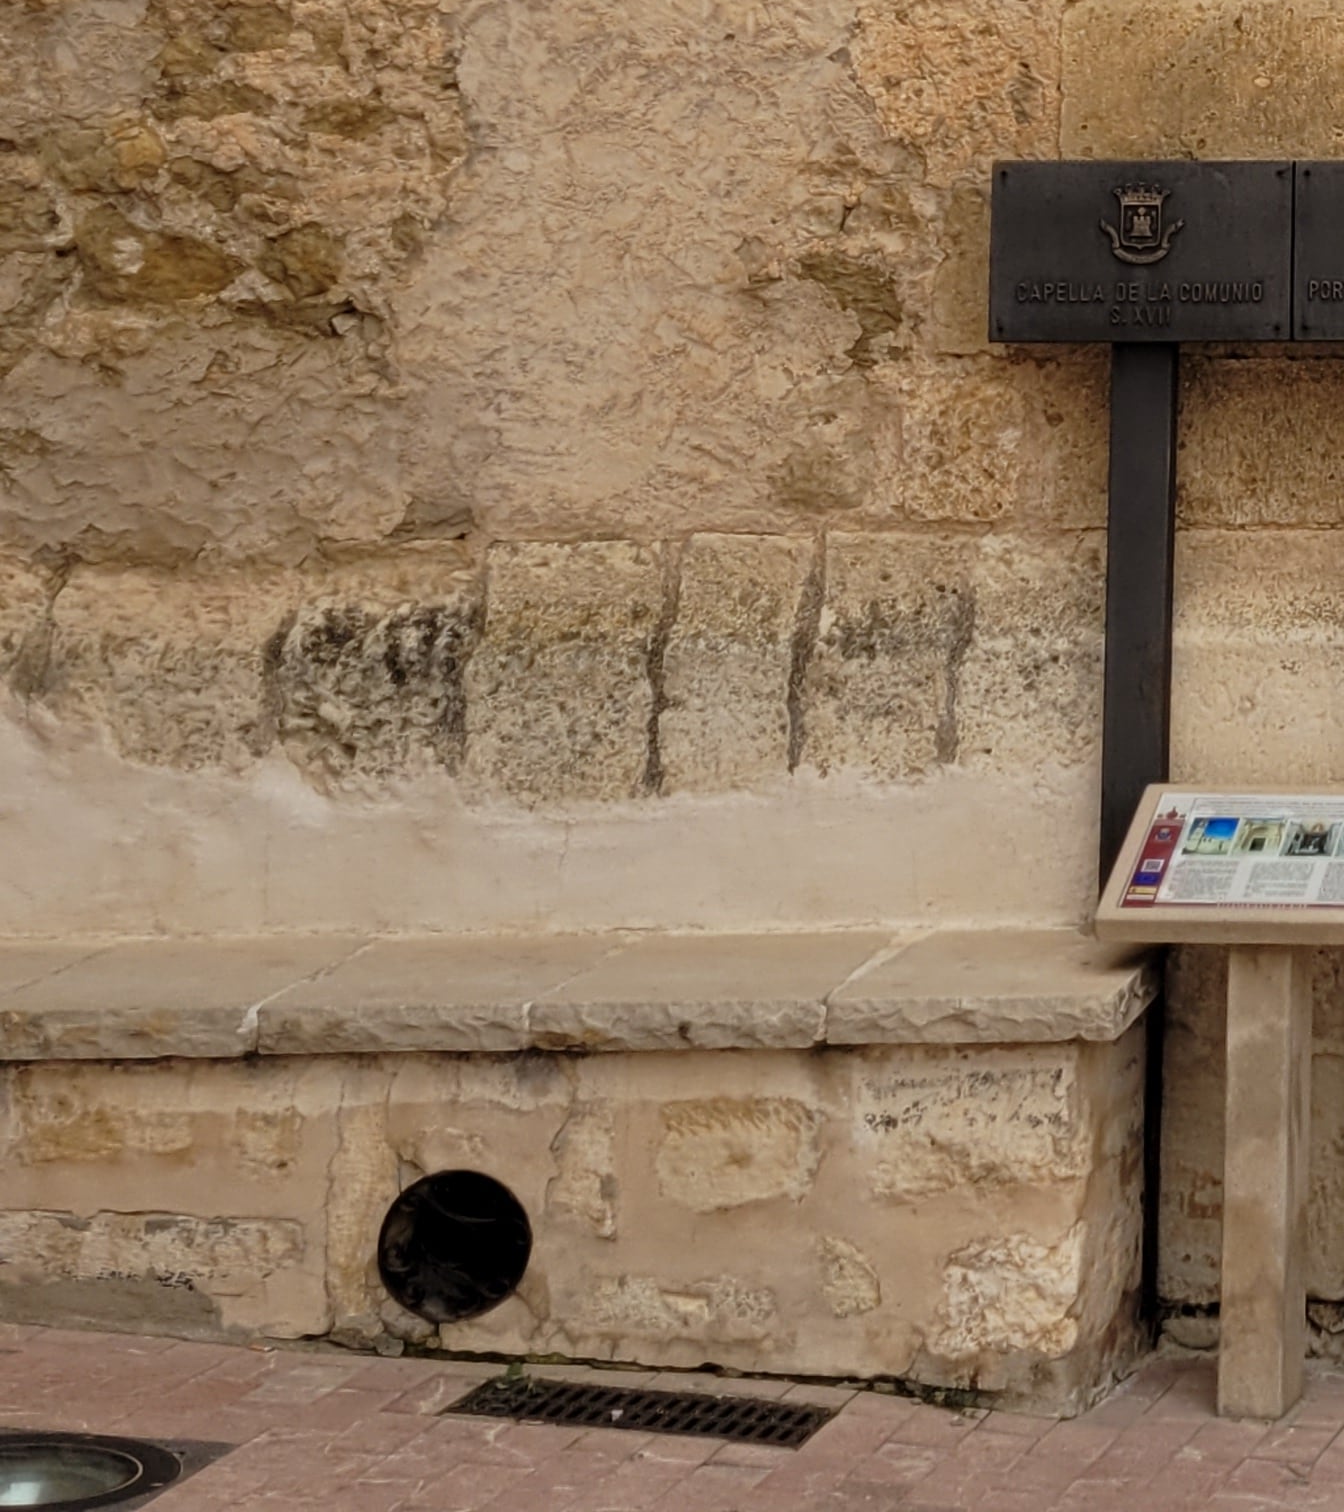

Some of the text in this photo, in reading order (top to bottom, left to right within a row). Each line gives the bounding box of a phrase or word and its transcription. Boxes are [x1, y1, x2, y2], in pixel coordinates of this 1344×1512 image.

[1016, 281, 1104, 303] CAPELLA
[1114, 282, 1138, 303] DE
[1148, 282, 1171, 303] LA
